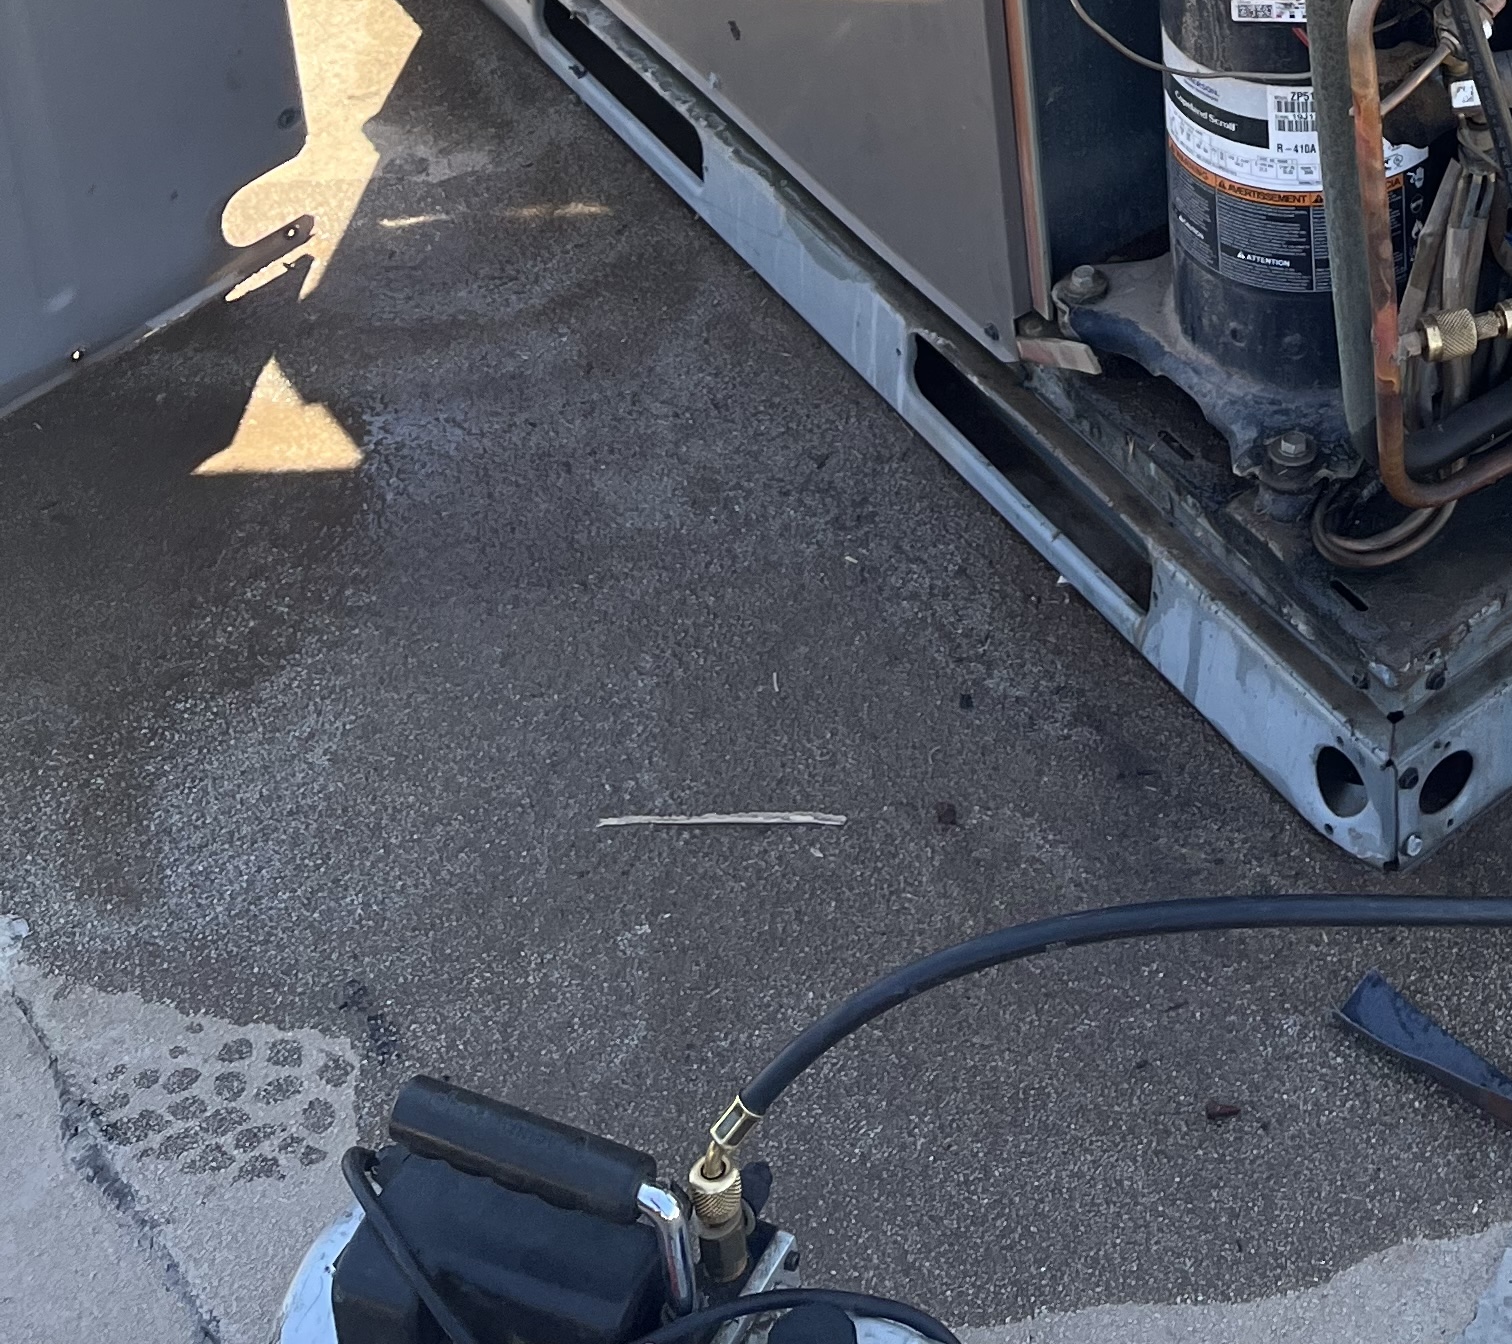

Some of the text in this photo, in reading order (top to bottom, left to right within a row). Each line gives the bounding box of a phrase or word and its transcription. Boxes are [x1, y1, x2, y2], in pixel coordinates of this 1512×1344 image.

[1276, 143, 1317, 154] R-410A
[1227, 184, 1308, 204] AVERTISSEMENT
[1246, 254, 1291, 268] ATTENTION
